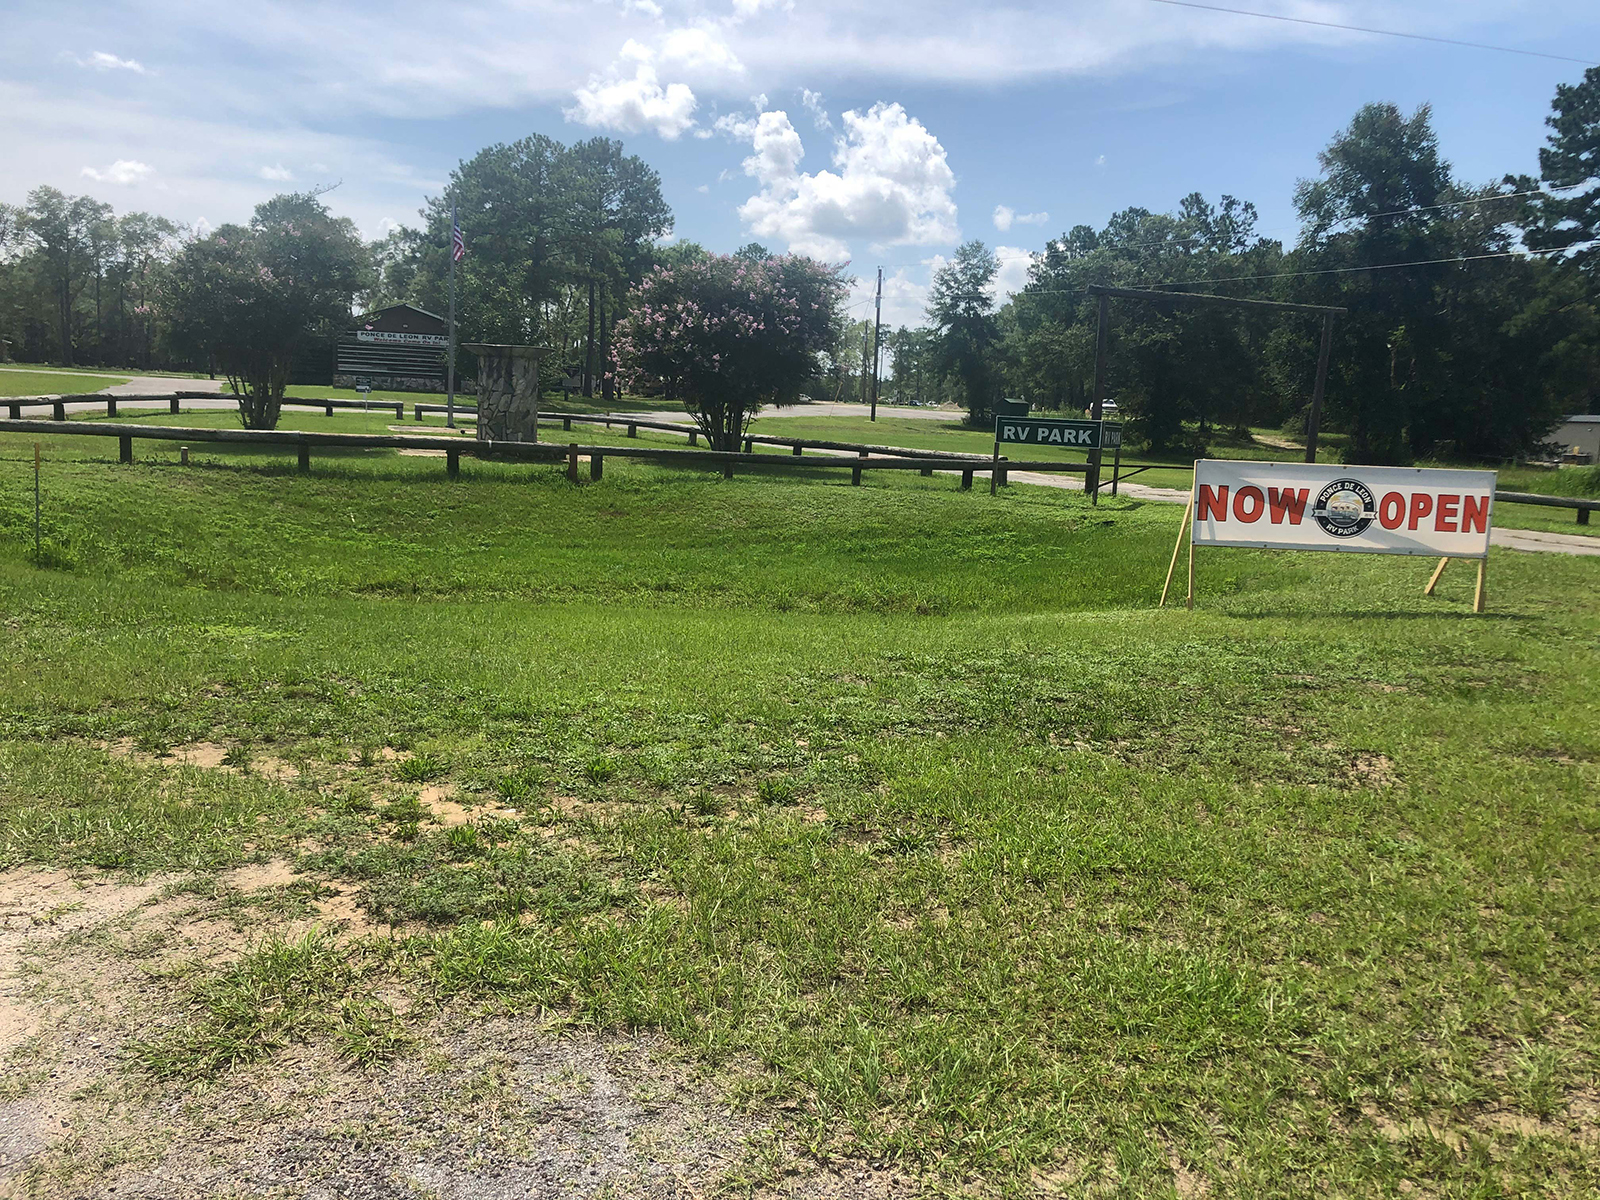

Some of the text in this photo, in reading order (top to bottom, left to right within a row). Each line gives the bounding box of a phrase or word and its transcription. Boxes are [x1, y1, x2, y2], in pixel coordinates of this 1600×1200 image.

[1003, 426, 1093, 444] RV PARK
[1319, 482, 1372, 503] PONCE DE LEON
[1196, 484, 1490, 534] NOW OPEN
[1326, 523, 1359, 535] RV PARK
